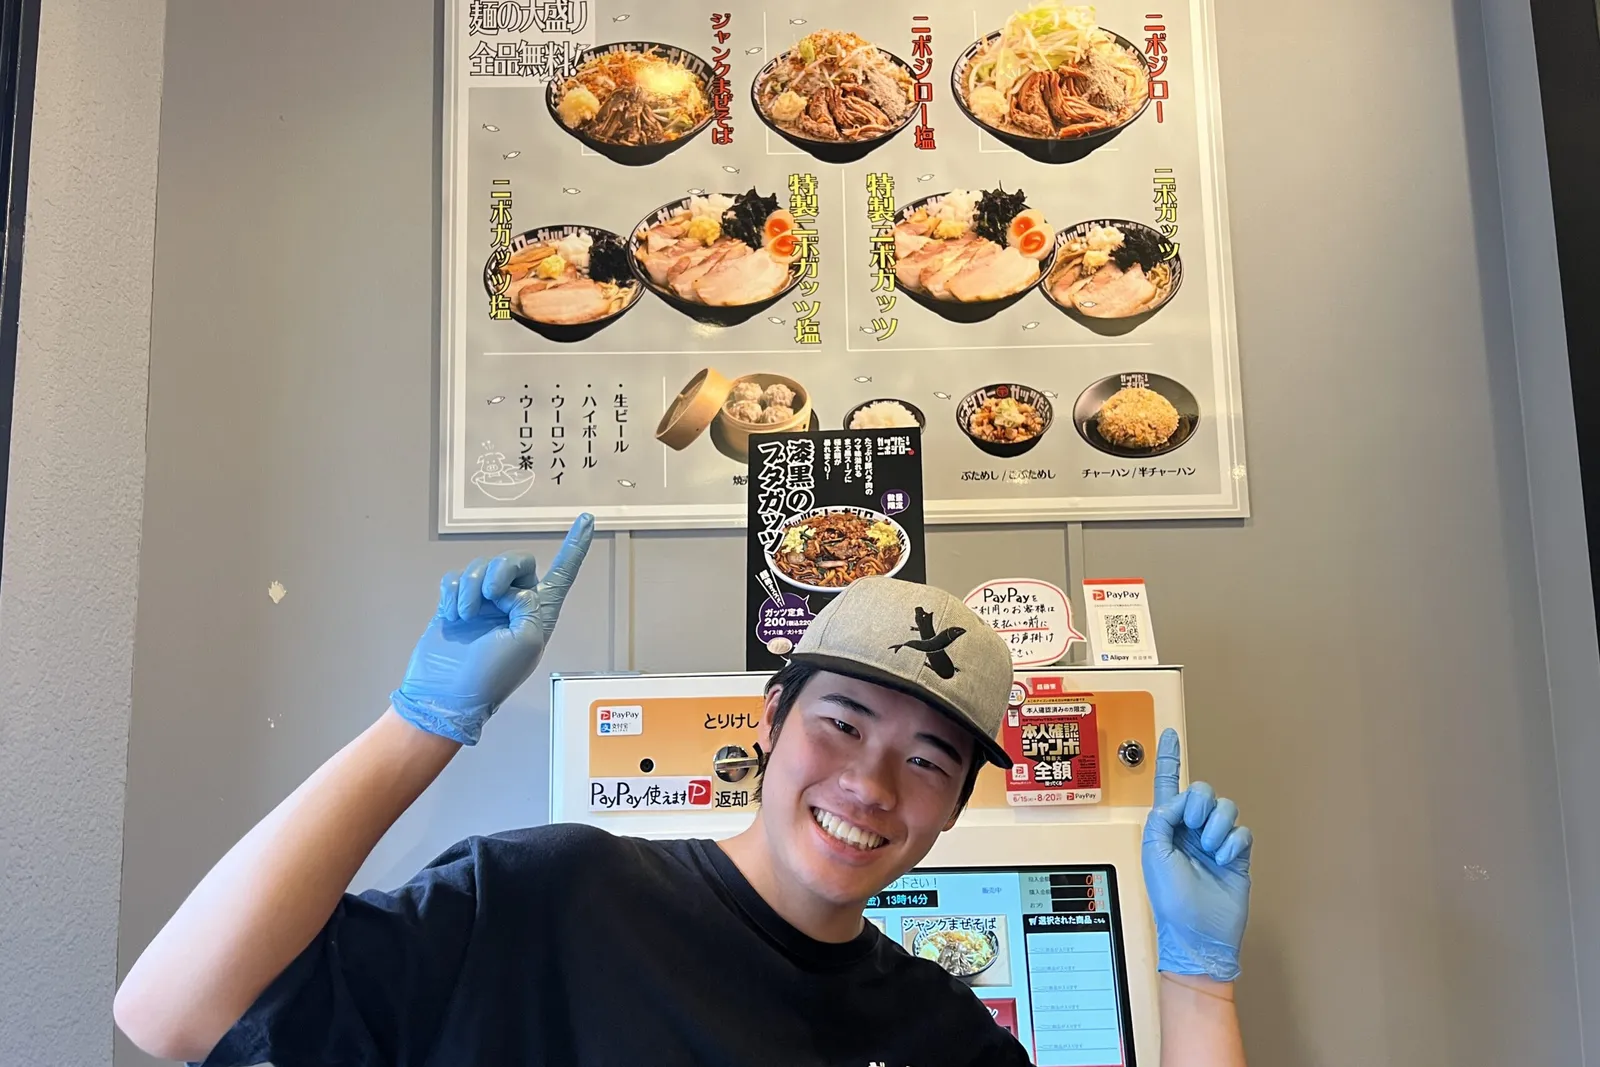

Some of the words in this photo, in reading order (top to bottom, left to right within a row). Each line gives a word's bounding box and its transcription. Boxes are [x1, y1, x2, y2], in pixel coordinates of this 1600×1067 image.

[469, 0, 589, 36] 麺の大盛り
[1144, 13, 1170, 124] ニボジロー
[709, 12, 734, 146] ジャンクまぜそば
[910, 15, 937, 151] ニボジロー塩
[1152, 168, 1181, 262] ニボガッツ
[489, 179, 513, 321] ニボガッツ塩
[787, 172, 821, 345] 特製ニボガッツ塩
[865, 172, 899, 343] 特製ニボガッツ
[785, 438, 815, 512] 漆黒の
[1106, 590, 1140, 600] PayPay
[764, 607, 805, 618] ガッツ定食
[985, 615, 1048, 629] 支払いの前に
[611, 711, 640, 720] PayPay
[1026, 705, 1087, 714] 本人確認済みの方限定
[703, 713, 760, 729] とりけし
[1021, 722, 1080, 740] 本人確認
[1021, 739, 1081, 757] ジャンボ
[1033, 760, 1073, 782] 全額
[714, 790, 749, 808] 返却
[1037, 793, 1057, 802] 8/20
[885, 893, 929, 906] 13時14分
[903, 917, 997, 933] ジャンクまぜそば
[1038, 915, 1093, 926] 選択された商品
